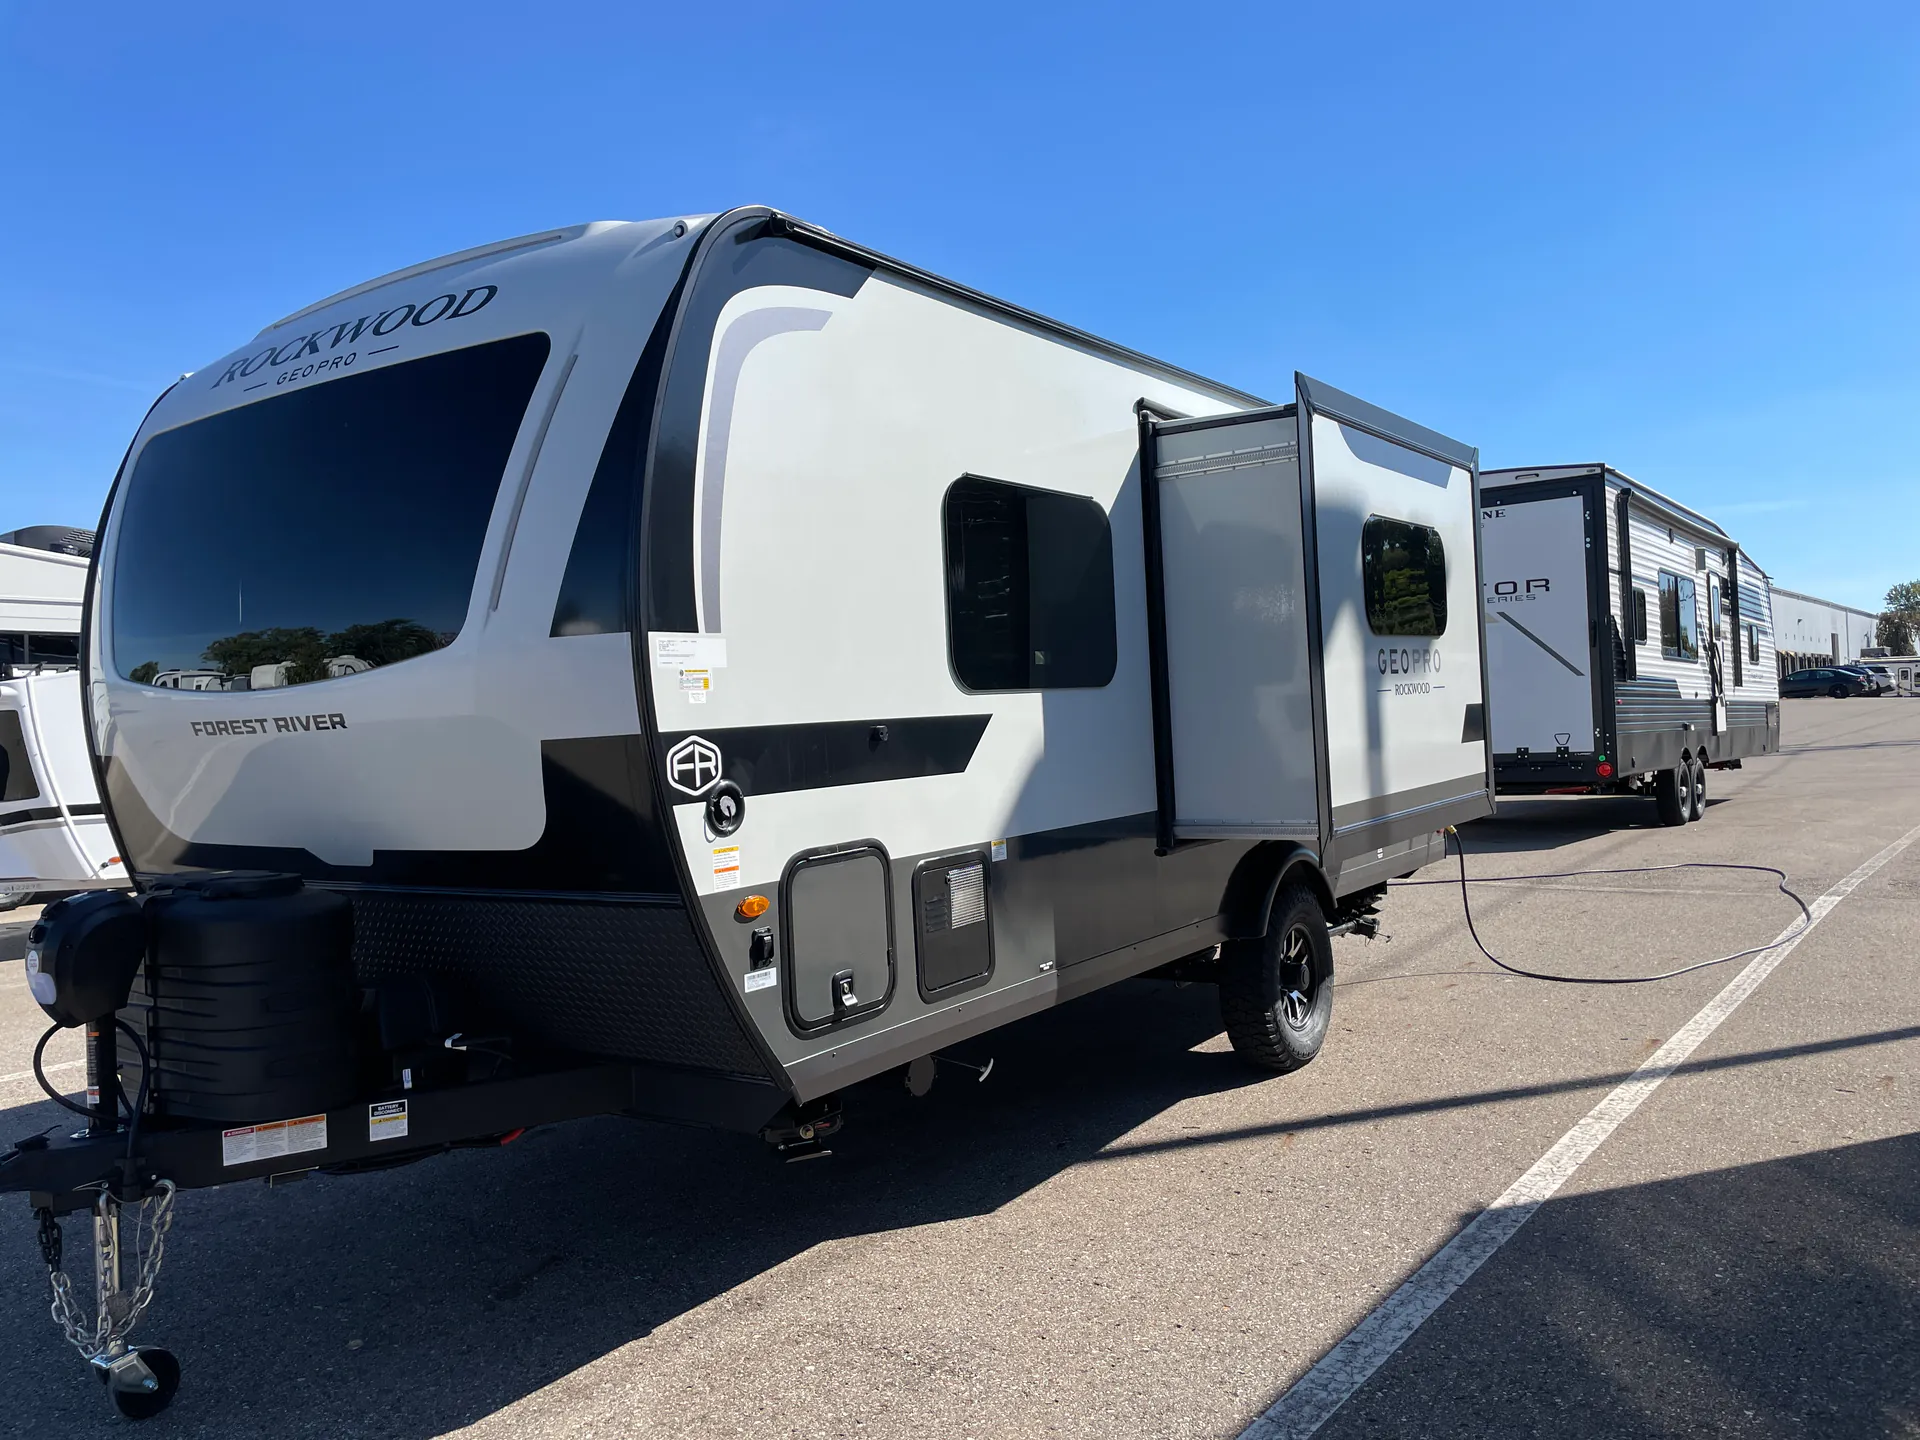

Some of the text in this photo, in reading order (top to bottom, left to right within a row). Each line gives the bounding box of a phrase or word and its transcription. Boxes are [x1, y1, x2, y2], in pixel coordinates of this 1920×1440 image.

[209, 284, 498, 391] ROCKWOOD
[276, 352, 357, 385] GEOPRO
[1484, 578, 1550, 596] OR
[1377, 648, 1441, 675] GEOPRO
[1394, 682, 1431, 696] ROCKWOOD
[190, 713, 348, 736] FOREST RIVER
[374, 1108, 403, 1116] DISCONNECT
